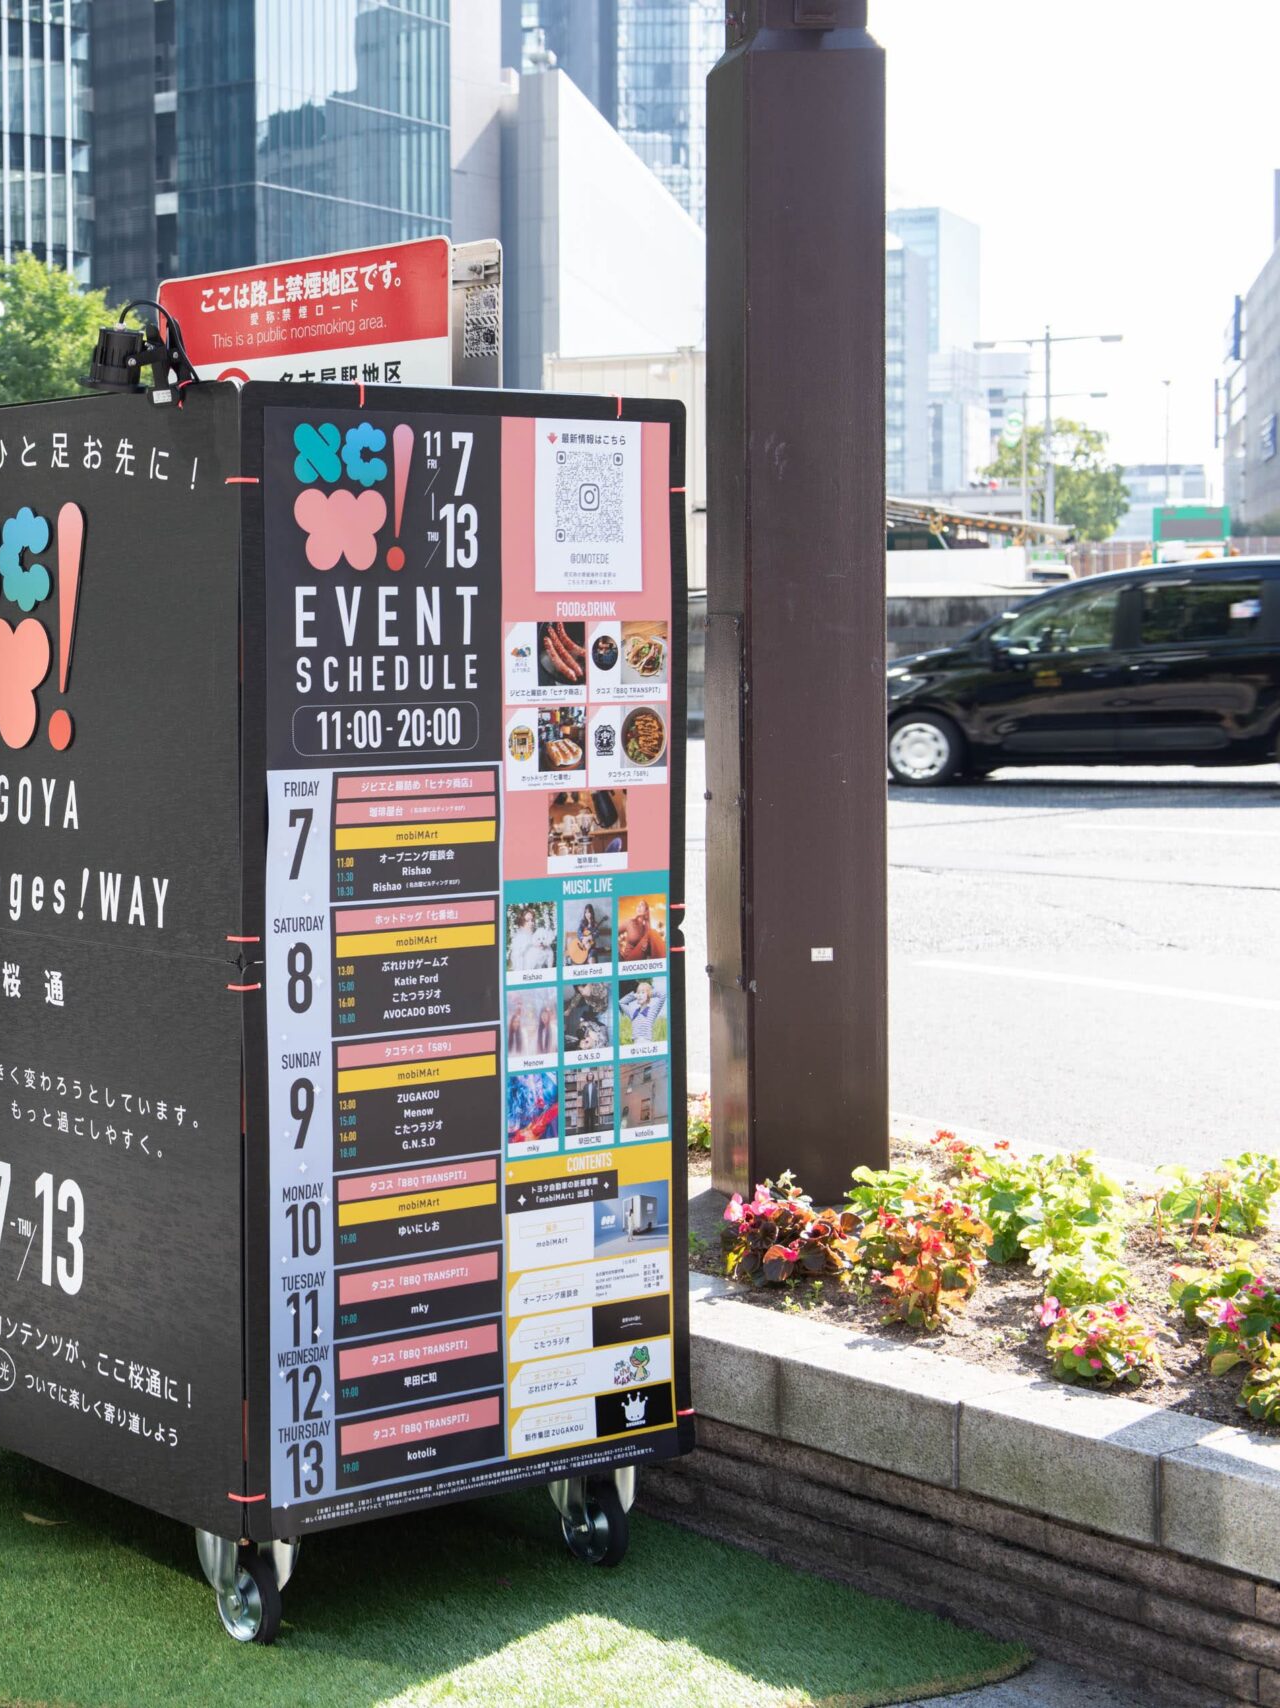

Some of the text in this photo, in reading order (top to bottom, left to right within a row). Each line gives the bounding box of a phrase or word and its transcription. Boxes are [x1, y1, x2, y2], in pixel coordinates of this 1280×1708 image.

[200, 260, 401, 312] ここは路上禁煙地区です。
[212, 315, 387, 349] This is a public nonsmoking area.
[561, 433, 626, 446] 最新情報はこちら
[427, 459, 437, 469] FRI
[452, 432, 474, 496] 7
[427, 504, 478, 568] THU 13
[295, 586, 478, 647] EVENT
[556, 601, 616, 617] FOOD&DRINK
[296, 654, 478, 693] SCHEDULE
[284, 780, 320, 797] FRIDAY
[289, 808, 313, 880] 7
[396, 831, 438, 841] mobiMArt
[379, 850, 455, 864] オープニング座談会
[402, 866, 432, 876] Rishao
[373, 882, 402, 892] Rishao
[562, 877, 613, 895] MUSIC LIVE
[273, 915, 325, 934] SATURDAY
[396, 936, 438, 947] mobiMArt
[573, 967, 603, 977] Katie Ford
[622, 962, 663, 972] AVOCADO BOYS
[287, 942, 313, 1014] 8
[394, 973, 439, 986] Katie Ford
[523, 973, 543, 981] Rishao
[392, 988, 442, 1002] こたつラジオ
[383, 1004, 451, 1020] AVOCADO BOYS
[281, 1051, 322, 1069] SUNDAY
[523, 1059, 544, 1068] Menow
[397, 1068, 439, 1080] mobiMArt
[397, 1089, 440, 1103] ZUGAKOU
[290, 1077, 314, 1150] 9
[403, 1107, 434, 1118] Menow
[394, 1119, 443, 1135] こたつラジオ
[402, 1137, 436, 1150] G.N.S.D
[527, 1144, 540, 1153] mky
[567, 1151, 612, 1173] CONTENTS
[282, 1183, 324, 1203] MONDAY
[398, 1198, 440, 1211] mobiMArt
[17, 1217, 31, 1237] THU
[35, 1171, 85, 1296] 13
[285, 1201, 322, 1258] 10
[398, 1221, 440, 1236] ゆいにしお
[536, 1237, 568, 1249] mobiMArt
[281, 1271, 326, 1292] TUESDAY
[411, 1303, 429, 1314] mky
[286, 1289, 319, 1347] 11
[534, 1336, 570, 1350] こたつラジオ
[278, 1345, 330, 1368] WEDNESDAY
[285, 1364, 323, 1423] 12
[25, 1373, 178, 1447] ついでに楽しく寄り道しよう
[278, 1420, 331, 1443] THURSDAY
[551, 1423, 584, 1437] ZUGAKOU
[407, 1447, 437, 1461] kotolis
[286, 1440, 324, 1498] 13
